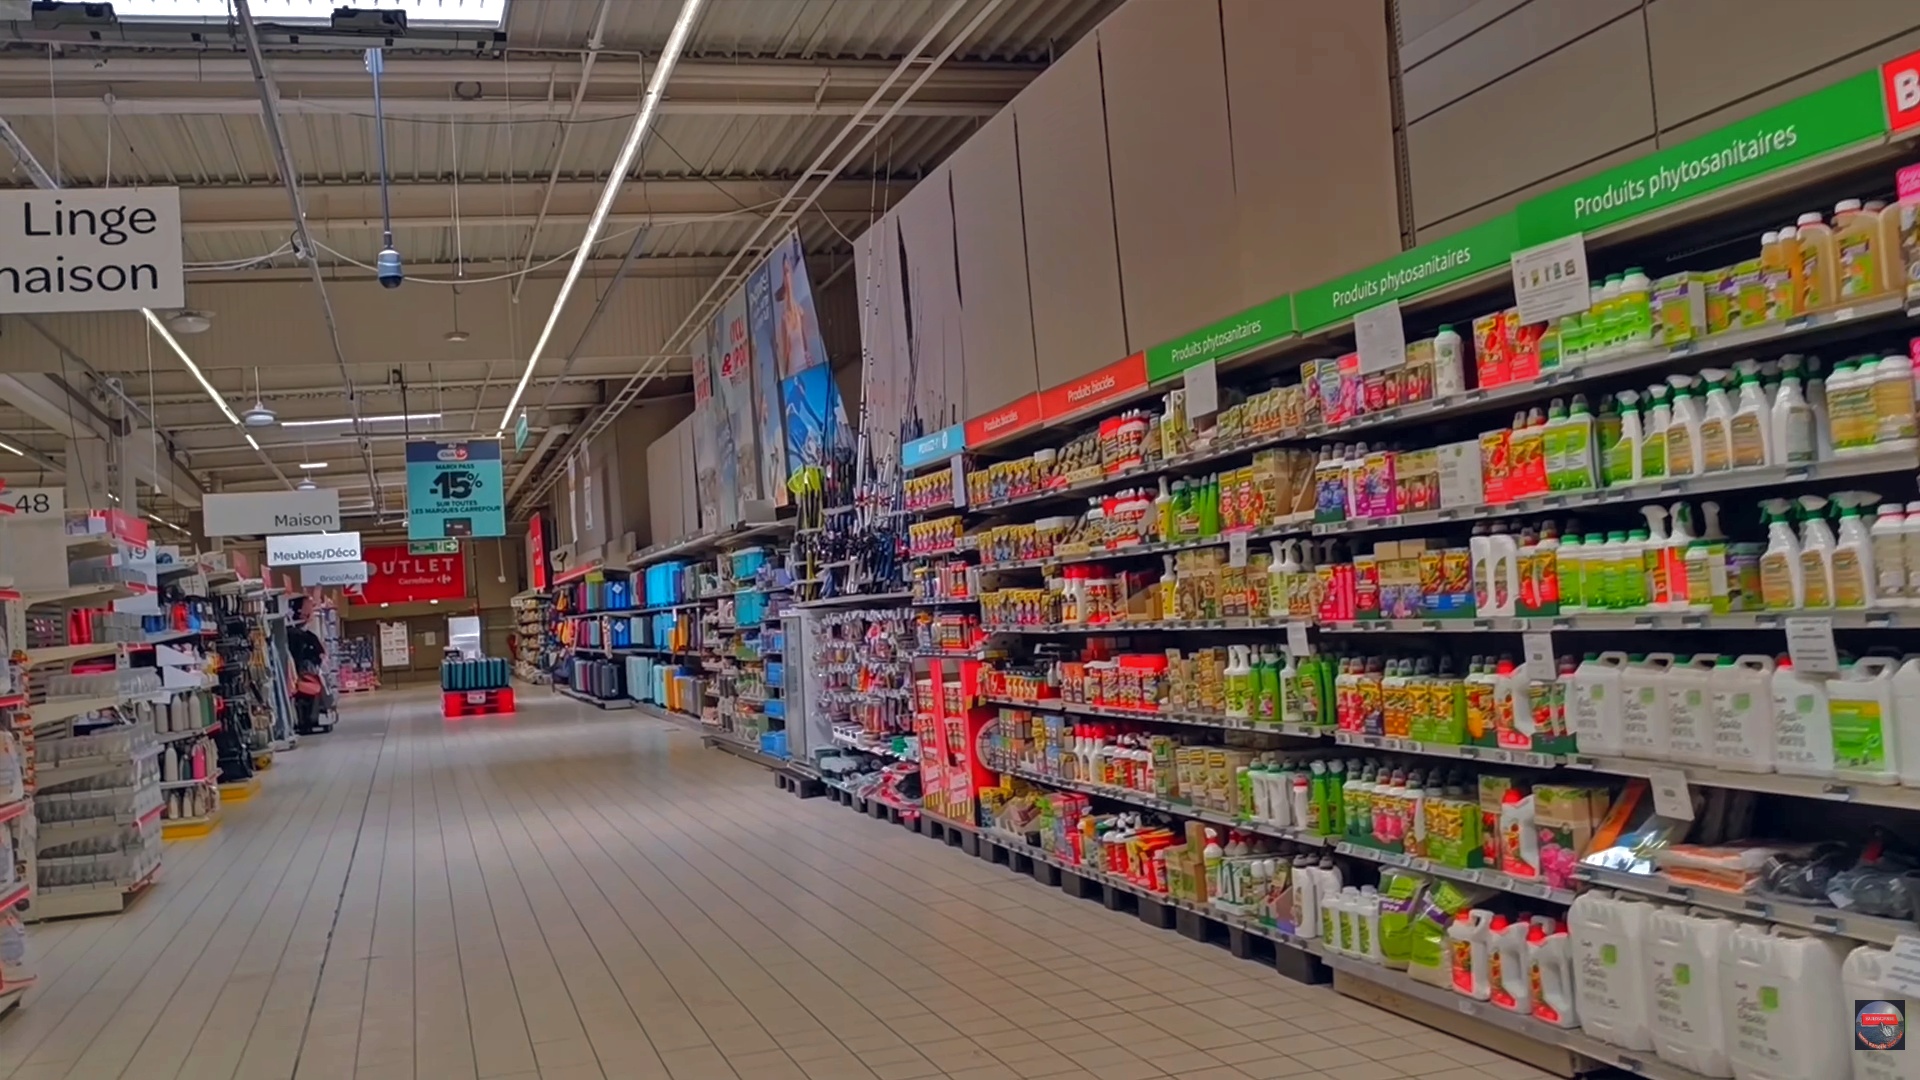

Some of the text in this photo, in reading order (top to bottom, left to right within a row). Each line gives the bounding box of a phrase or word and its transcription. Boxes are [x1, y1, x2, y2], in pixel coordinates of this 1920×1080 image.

[1574, 124, 1797, 218] Produits phytosanitaires
[24, 199, 156, 245] Linge
[1333, 247, 1471, 307] Produits phytosanitaires
[1172, 320, 1262, 363] Produits phytosanitaires
[1067, 375, 1115, 403] Produits biocides
[429, 471, 483, 499] -15%
[15, 493, 50, 514] 48
[460, 505, 501, 513] CARREFOUR
[274, 512, 333, 528] Maison
[273, 547, 357, 562] Meubles/Déco
[398, 576, 434, 585] Carrefour
